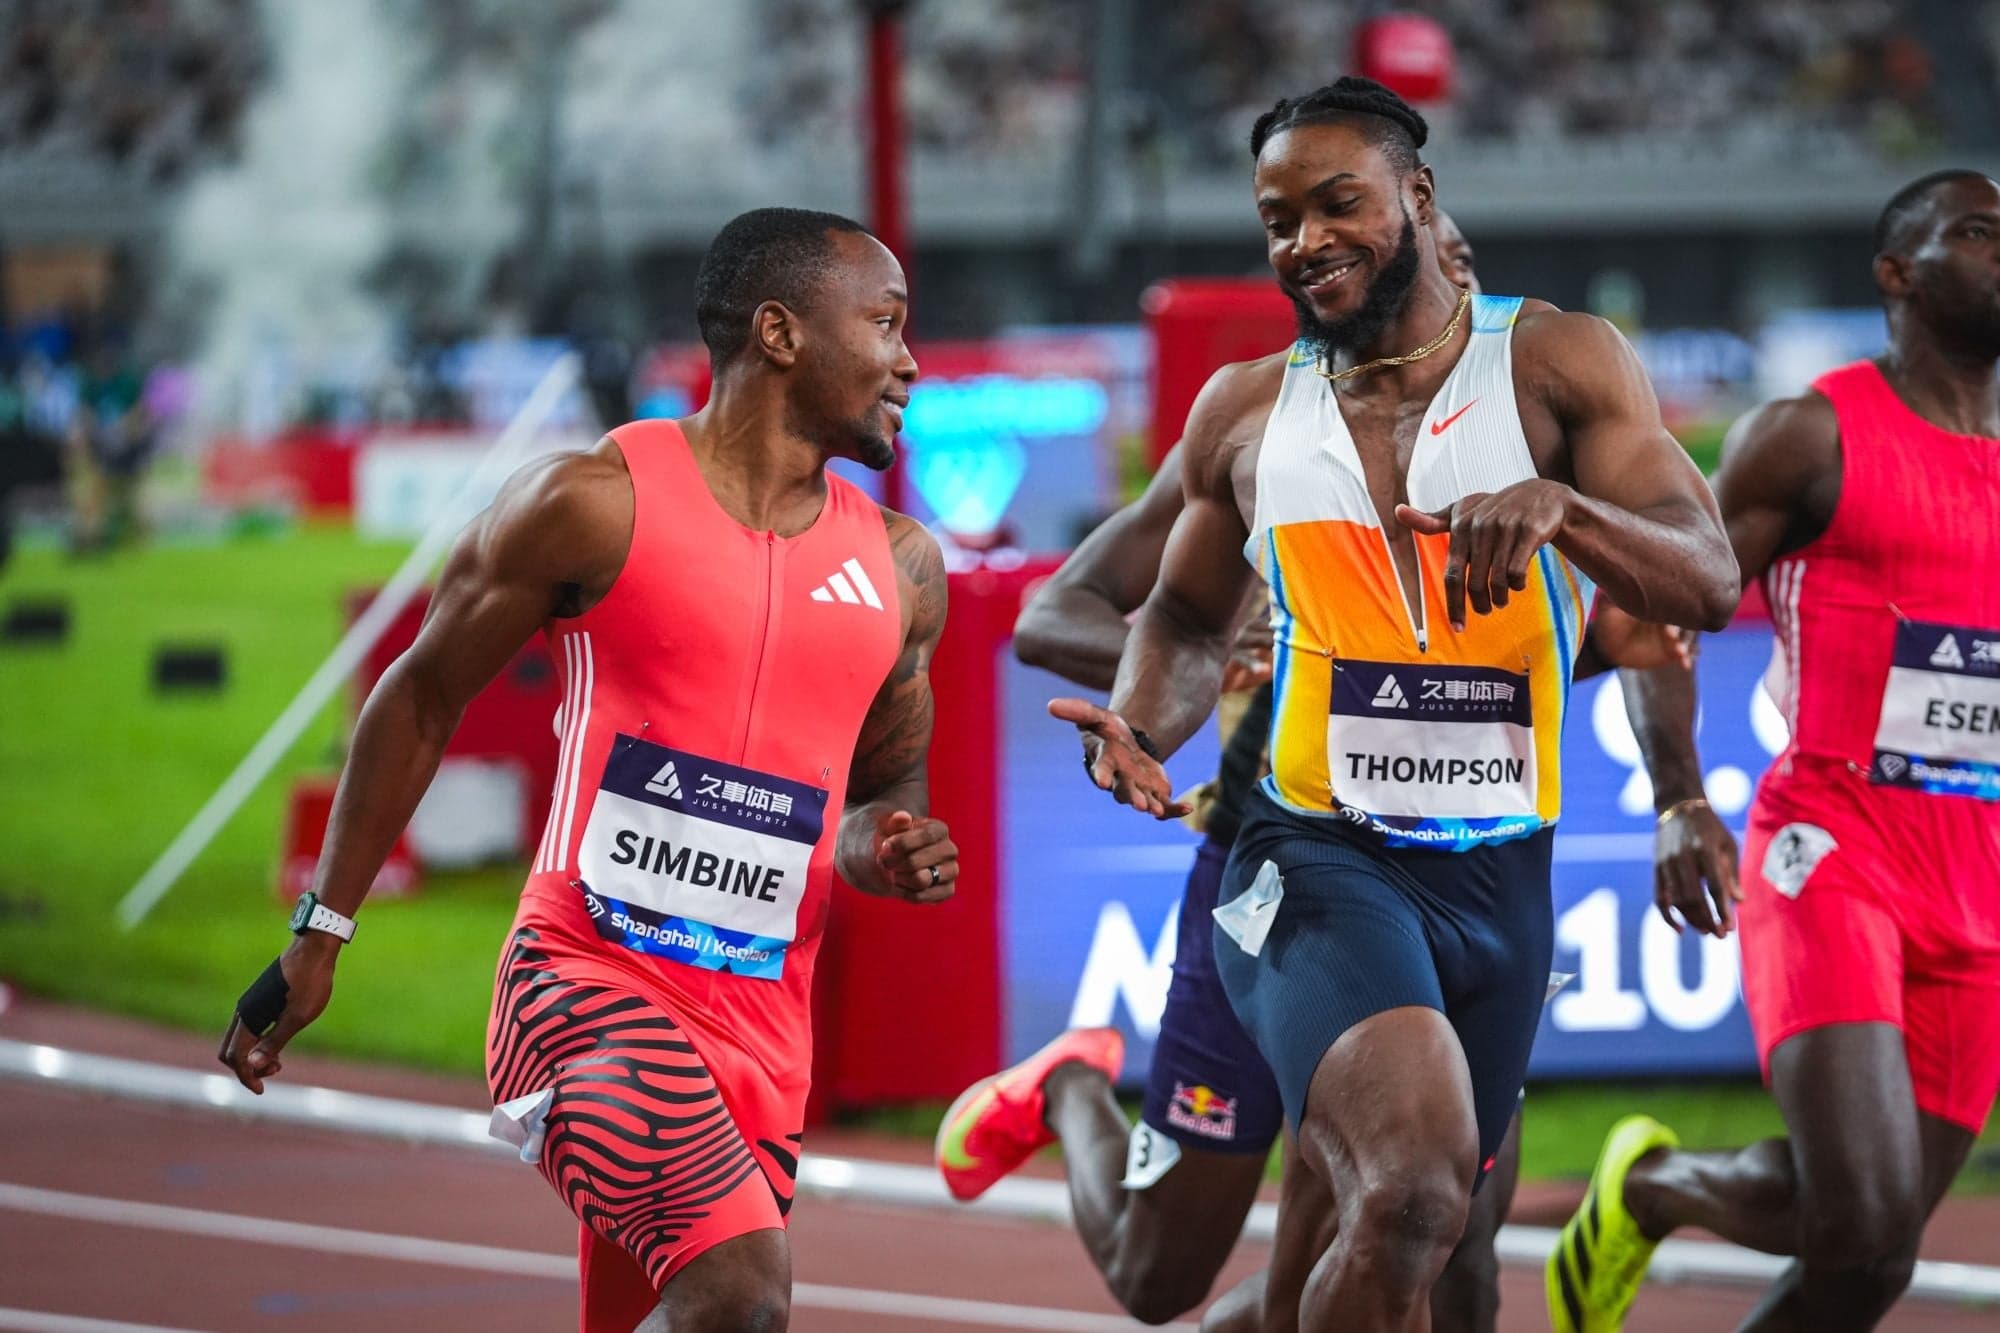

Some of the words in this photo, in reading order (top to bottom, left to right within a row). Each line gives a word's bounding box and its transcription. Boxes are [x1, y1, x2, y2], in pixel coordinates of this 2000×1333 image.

[1419, 703, 1454, 711] JUSS
[1420, 679, 1515, 702] 久事体育
[1346, 753, 1525, 785] THOMPSON
[696, 774, 793, 816] 久事体育
[692, 798, 727, 812] JUSS
[737, 809, 787, 827] SPORTS
[609, 830, 784, 903] SIMBINE
[611, 912, 701, 951] Shanghai
[1137, 1131, 1152, 1168] 3
